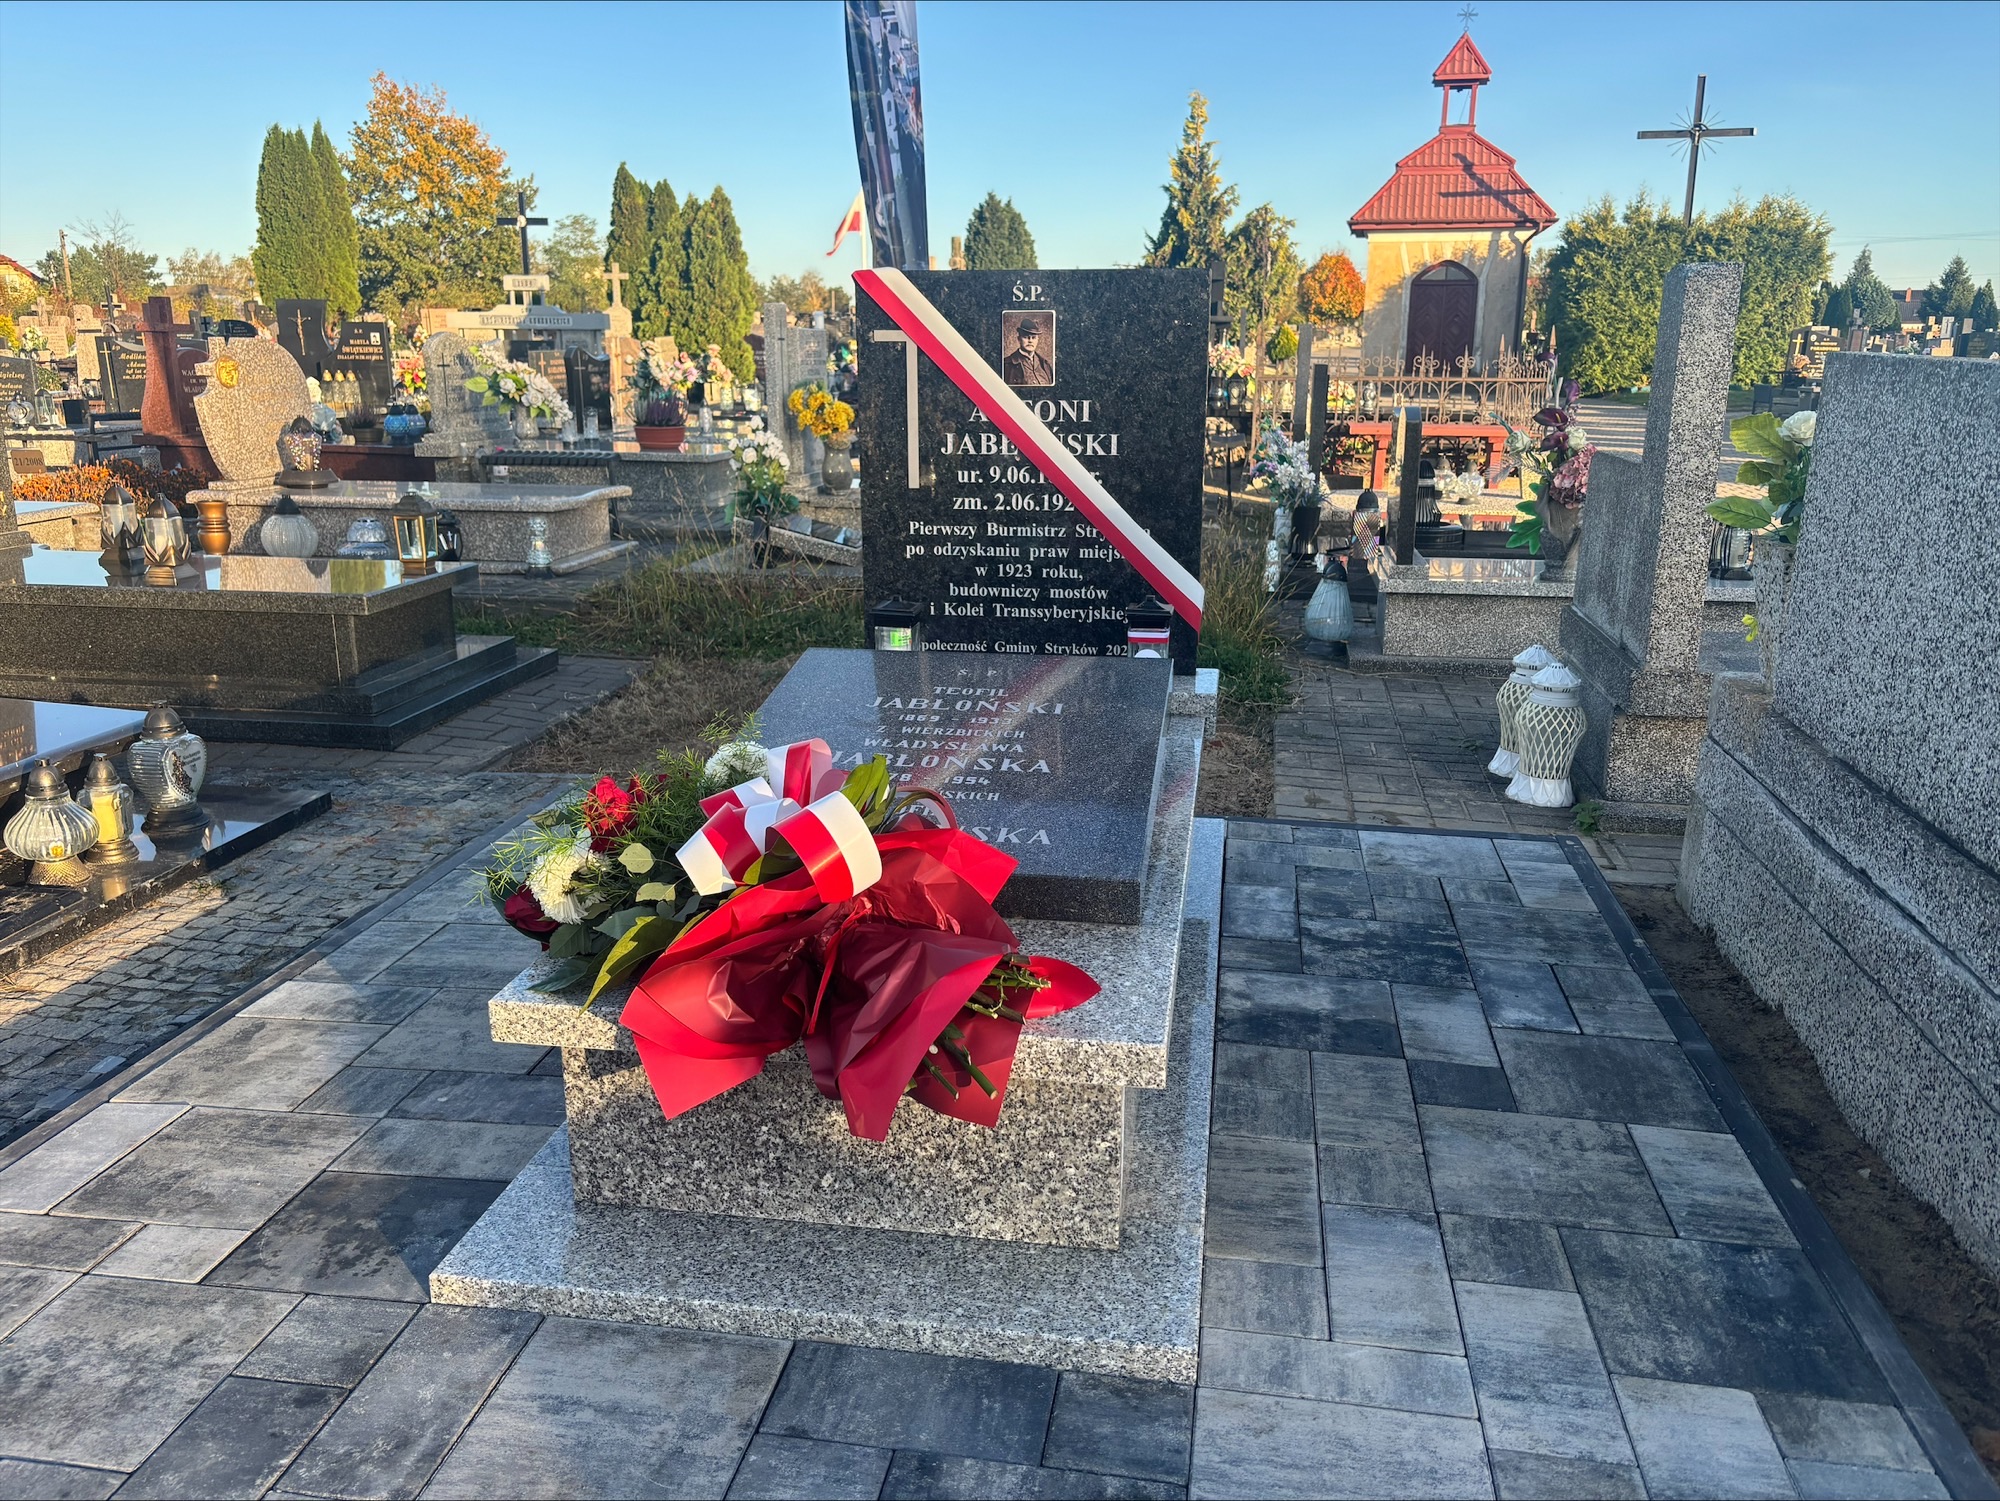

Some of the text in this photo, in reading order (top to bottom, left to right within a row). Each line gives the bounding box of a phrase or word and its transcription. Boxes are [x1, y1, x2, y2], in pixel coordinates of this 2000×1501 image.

[1012, 280, 1046, 301] Ś.P.
[968, 399, 1092, 423] AONI
[940, 426, 1120, 456] JABŁSKI
[957, 470, 984, 484] ur.
[989, 466, 1053, 484] 9.06.1
[953, 493, 1075, 512] zm. 2.06.192
[908, 520, 978, 540] Pierwszy
[986, 522, 1067, 537] Burmistrz
[906, 542, 1126, 562] po odzyskaniu praw miejs
[974, 563, 1084, 581] w 1923 roku,
[949, 582, 1109, 602] budowniczy mostów
[929, 602, 935, 616] i
[943, 602, 985, 617] Kolei
[921, 640, 1128, 656] połeczność Gminy Stryków 202
[933, 686, 1009, 697] TEOFIL
[899, 714, 940, 722] 1869
[876, 725, 1026, 739] Z WIERZBICKICH
[864, 738, 1024, 753] WŁADYSŁAWA
[941, 790, 1000, 801] SKICH
